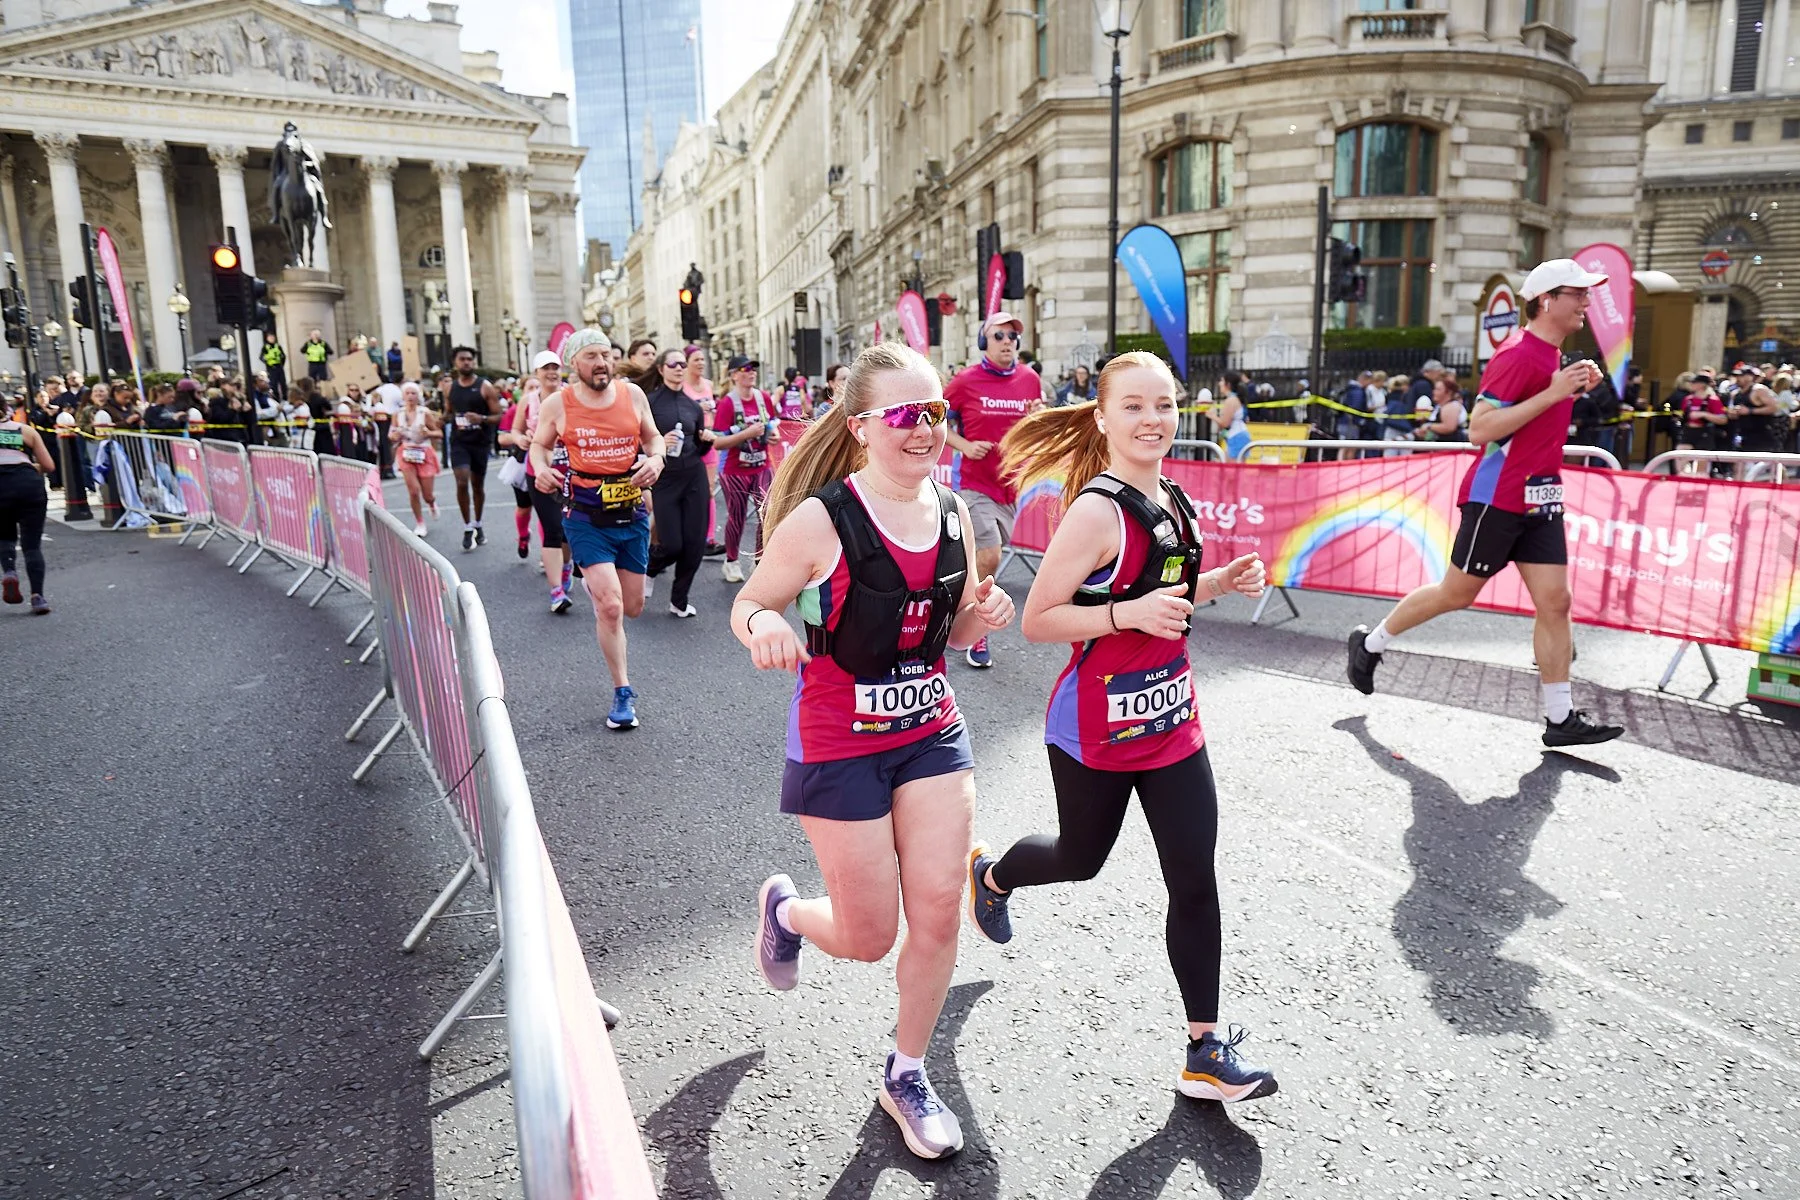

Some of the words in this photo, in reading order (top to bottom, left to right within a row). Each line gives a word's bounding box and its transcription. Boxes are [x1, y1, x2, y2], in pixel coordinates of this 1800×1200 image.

[575, 427, 597, 437] The
[1528, 486, 1563, 501] 11399
[1192, 497, 1265, 529] my's
[1563, 512, 1734, 567] mmy's
[1673, 574, 1732, 596] charity
[1145, 669, 1169, 682] ALICE
[864, 677, 945, 712] 10009
[1117, 675, 1187, 717] 10007
